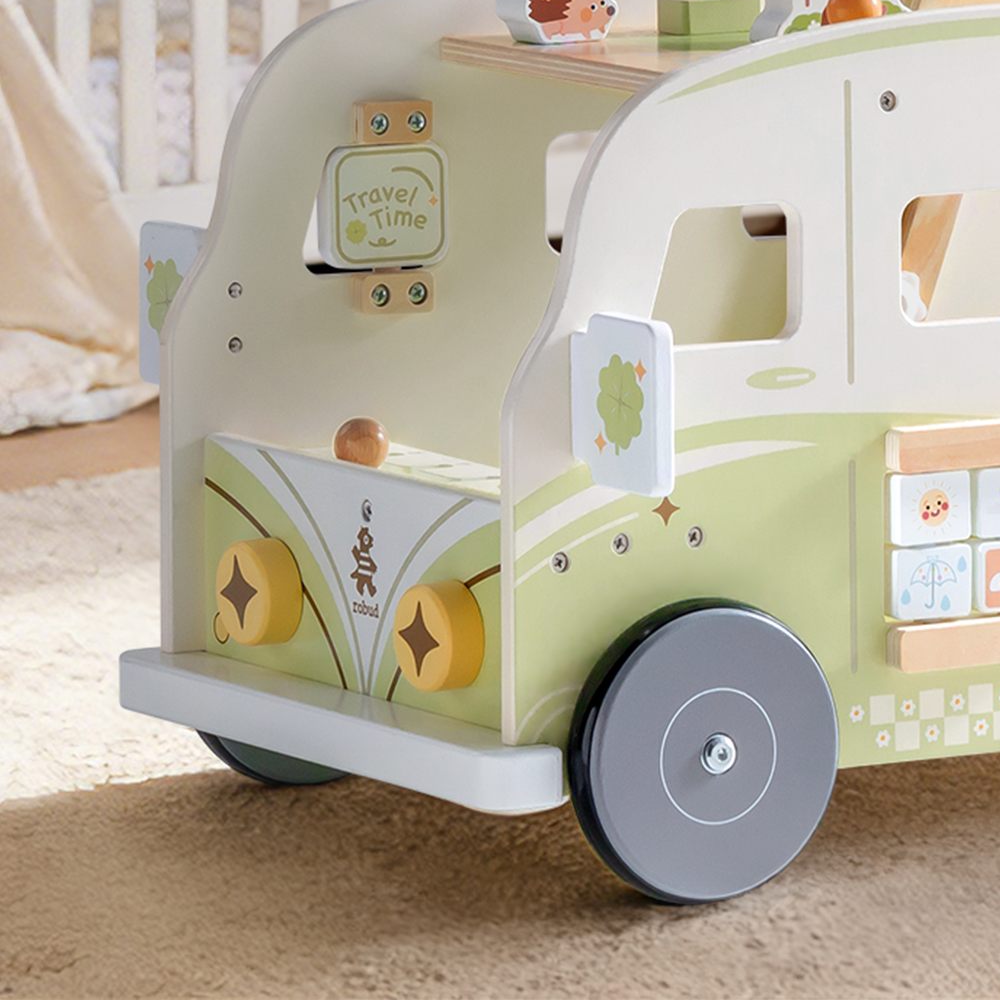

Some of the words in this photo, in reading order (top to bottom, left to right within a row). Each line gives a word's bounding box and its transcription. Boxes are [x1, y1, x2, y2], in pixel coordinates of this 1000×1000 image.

[342, 186, 419, 214] Travel
[368, 206, 428, 230] Time
[352, 600, 379, 619] robud
